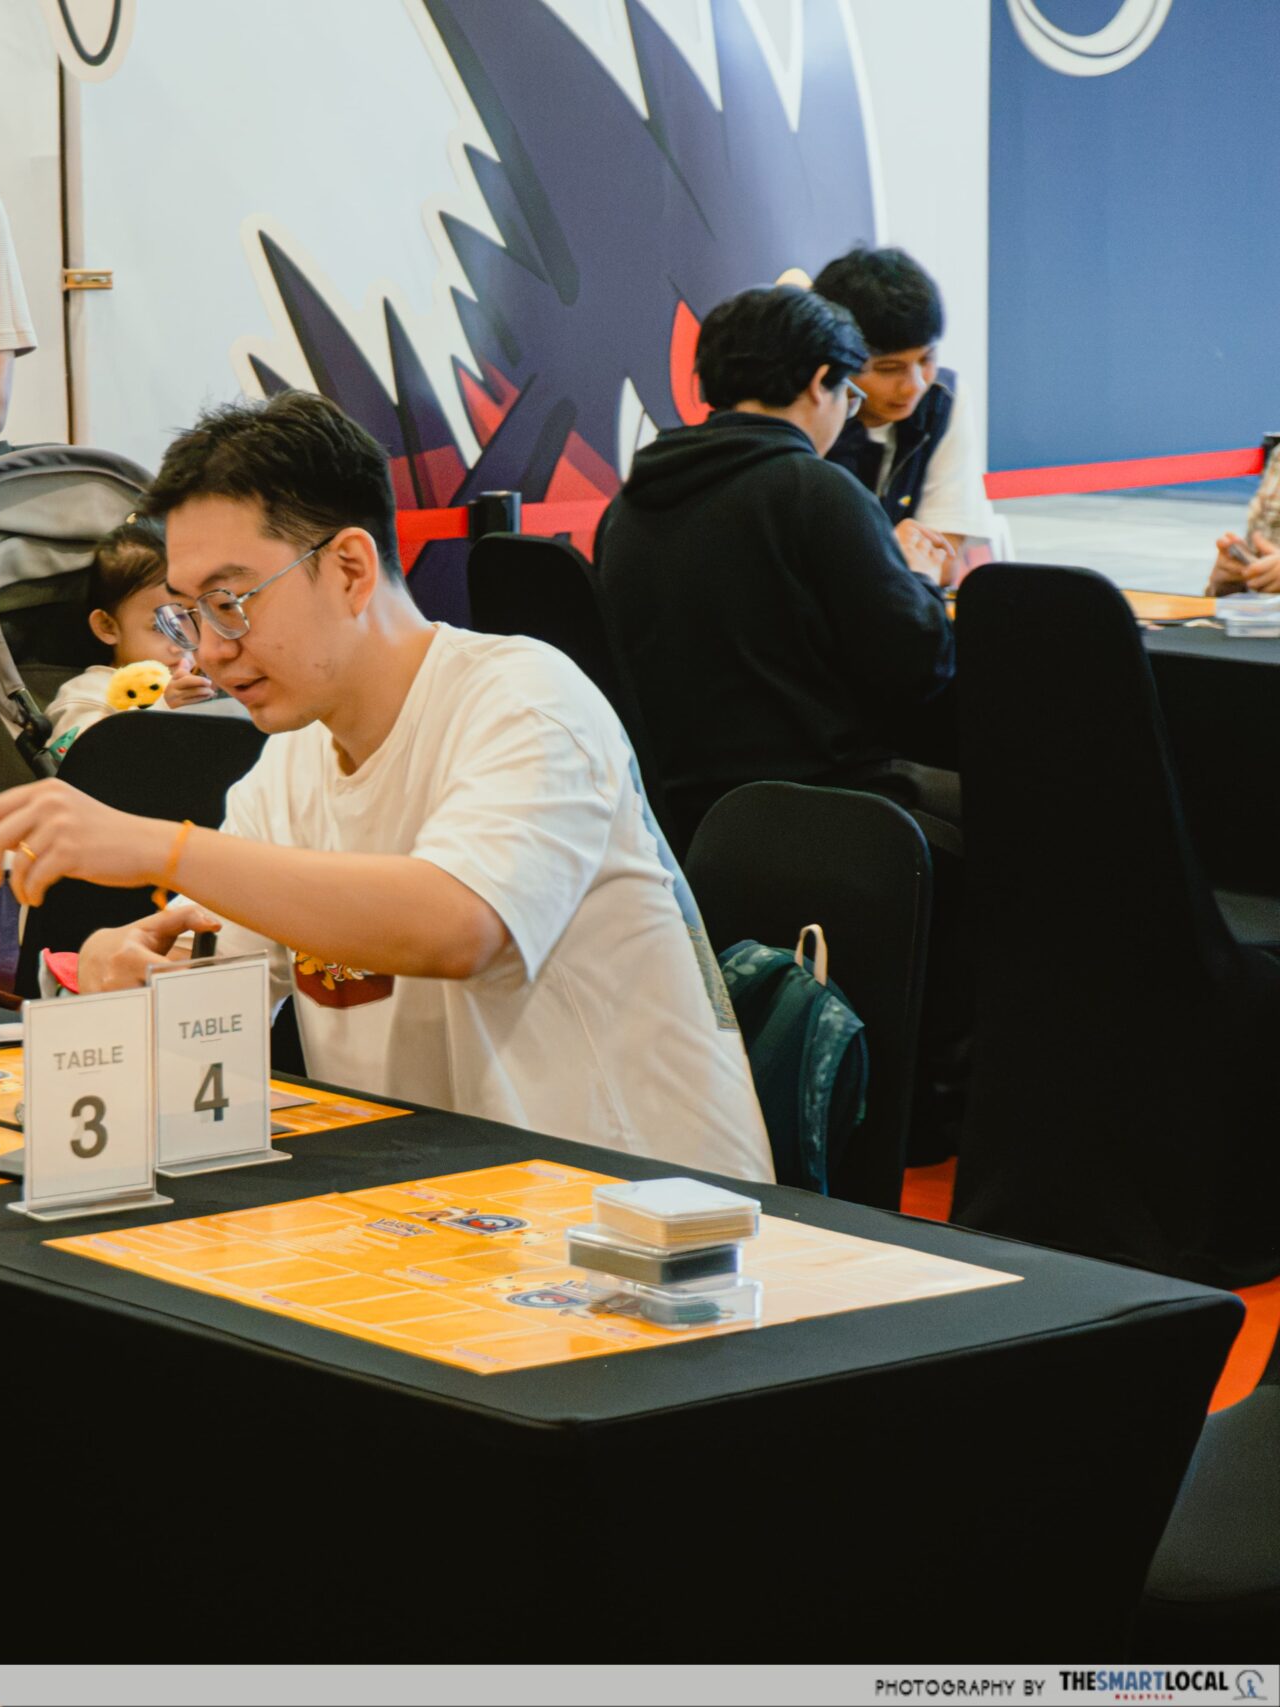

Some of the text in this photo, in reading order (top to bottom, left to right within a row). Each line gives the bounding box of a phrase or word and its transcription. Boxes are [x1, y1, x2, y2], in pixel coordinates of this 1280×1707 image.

[177, 1013, 243, 1040] TABLE
[53, 1045, 124, 1071] TABLE
[193, 1061, 230, 1123] 4
[69, 1094, 108, 1159] 3
